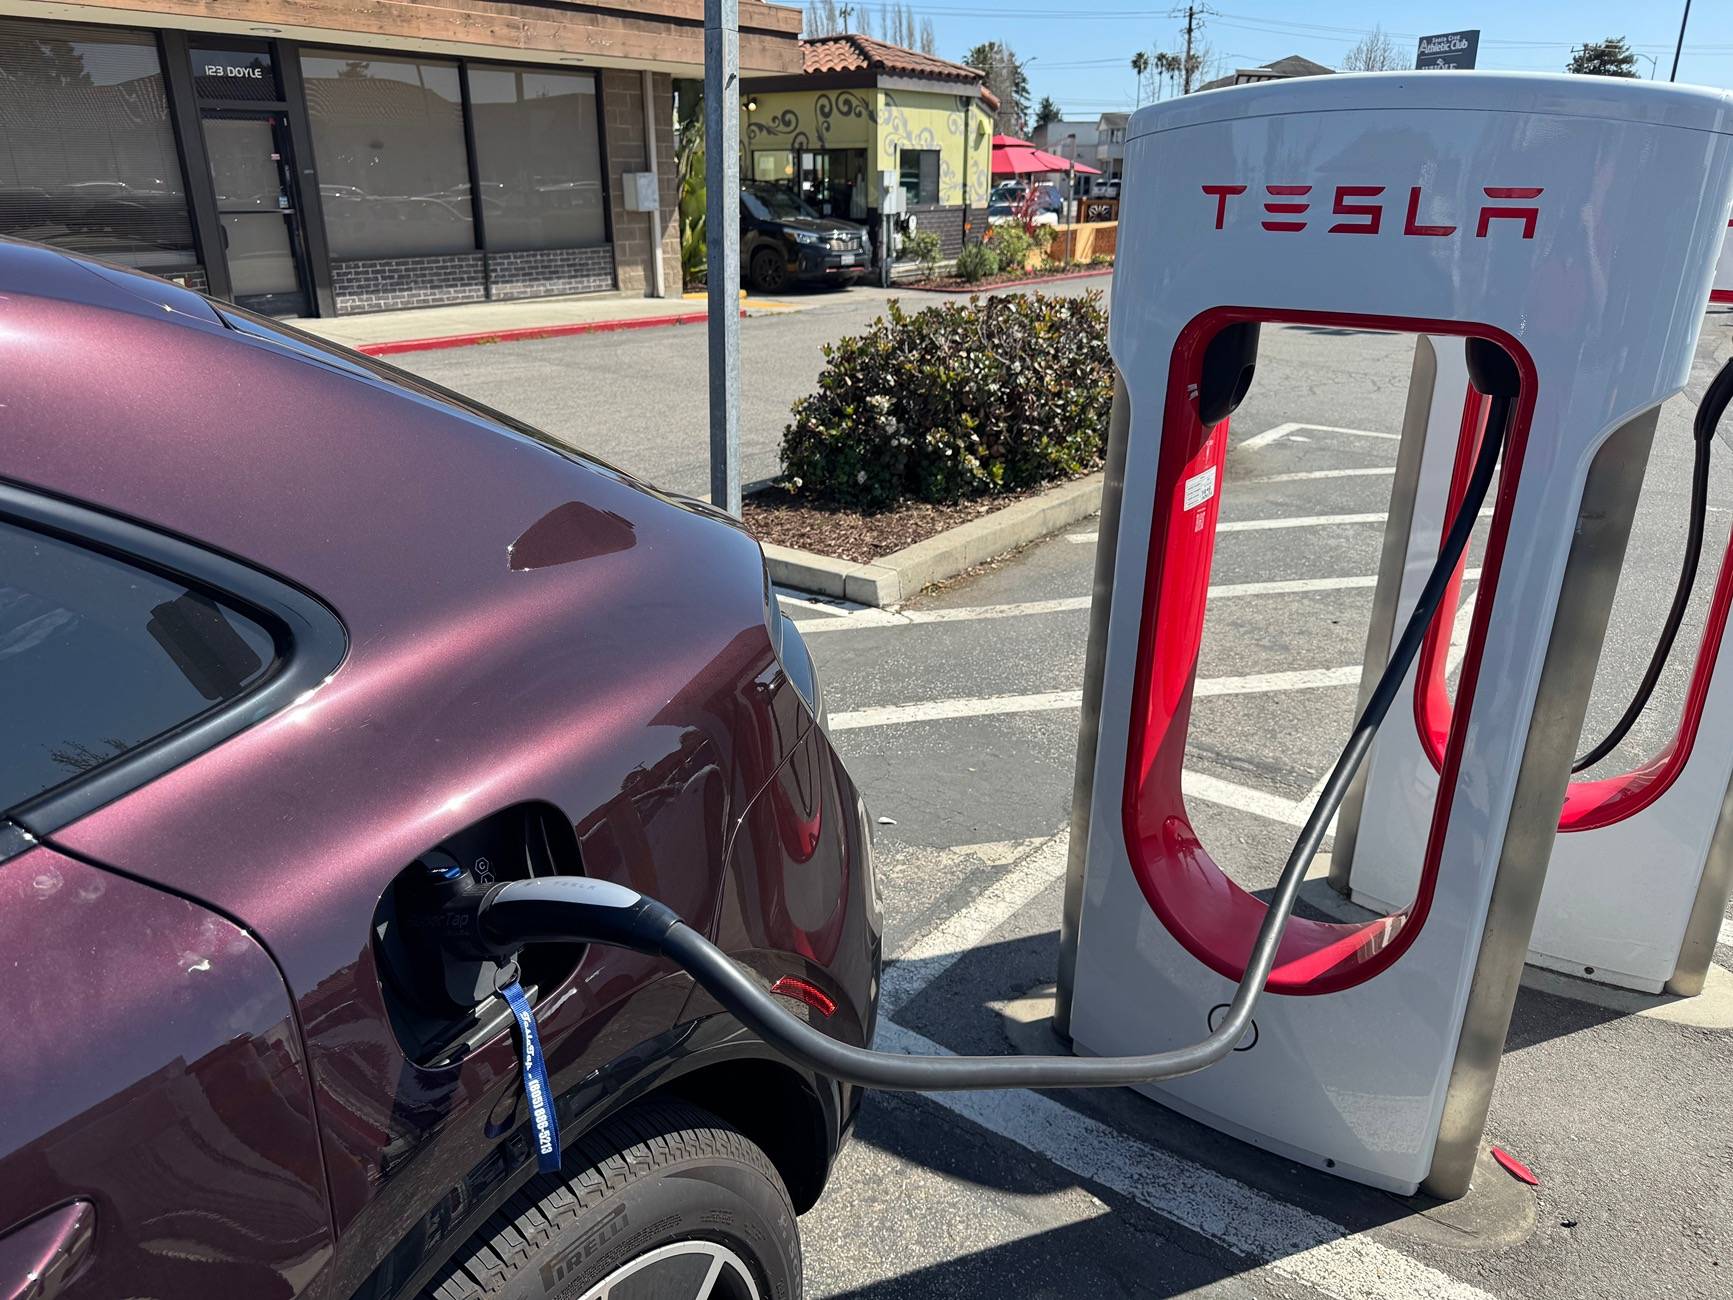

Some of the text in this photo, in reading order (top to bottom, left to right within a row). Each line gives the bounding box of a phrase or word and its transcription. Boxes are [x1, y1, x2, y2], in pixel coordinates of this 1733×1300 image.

[1418, 39, 1468, 54] Athletic Club
[205, 65, 262, 79] 123 DOYLE
[1201, 185, 1545, 239] TESLA
[538, 1202, 629, 1294] PIRELLI
